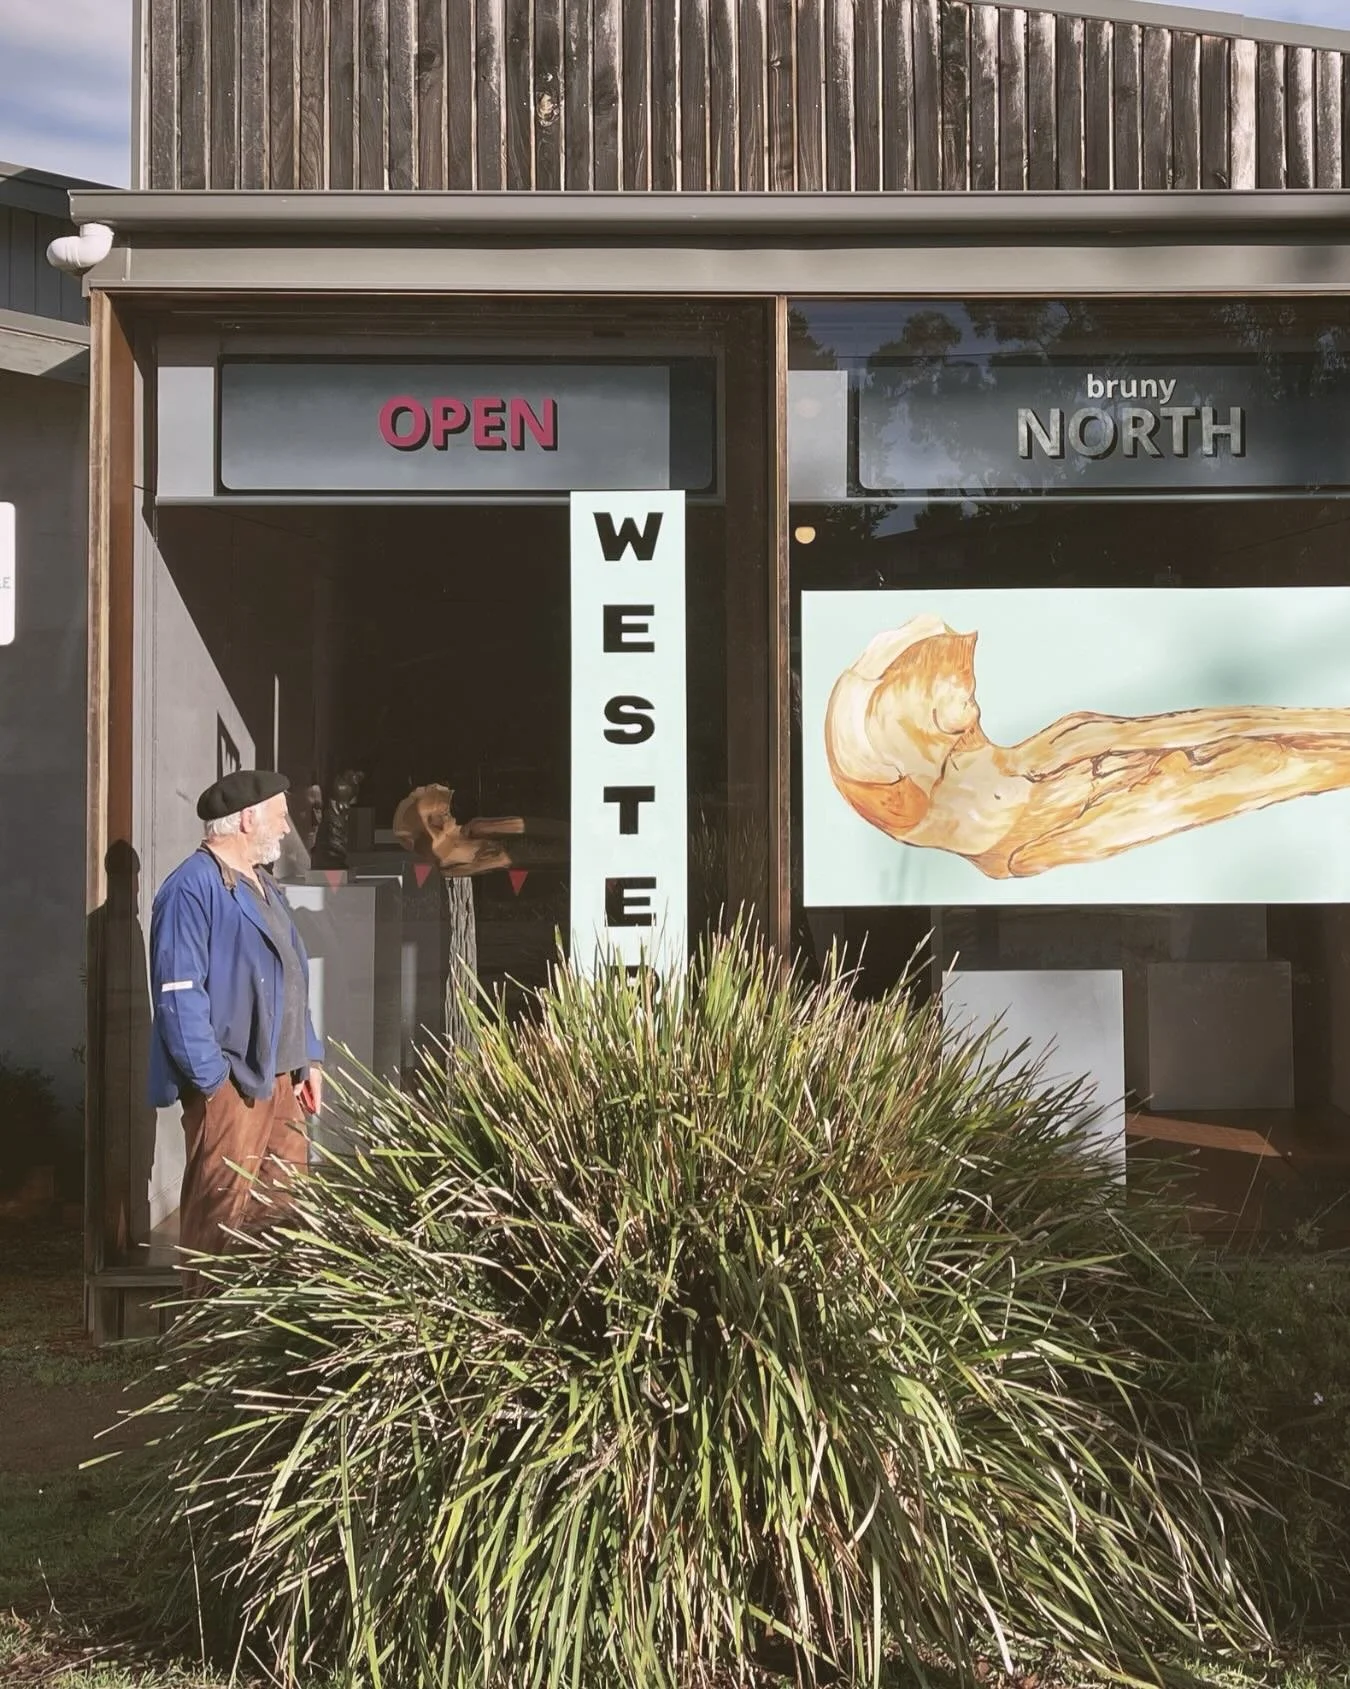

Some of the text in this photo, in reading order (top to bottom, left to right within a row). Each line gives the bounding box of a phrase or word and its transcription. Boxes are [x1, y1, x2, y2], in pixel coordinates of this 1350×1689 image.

[1087, 373, 1176, 404] bruny
[379, 394, 557, 451] OPEN
[1017, 406, 1245, 459] NORTH
